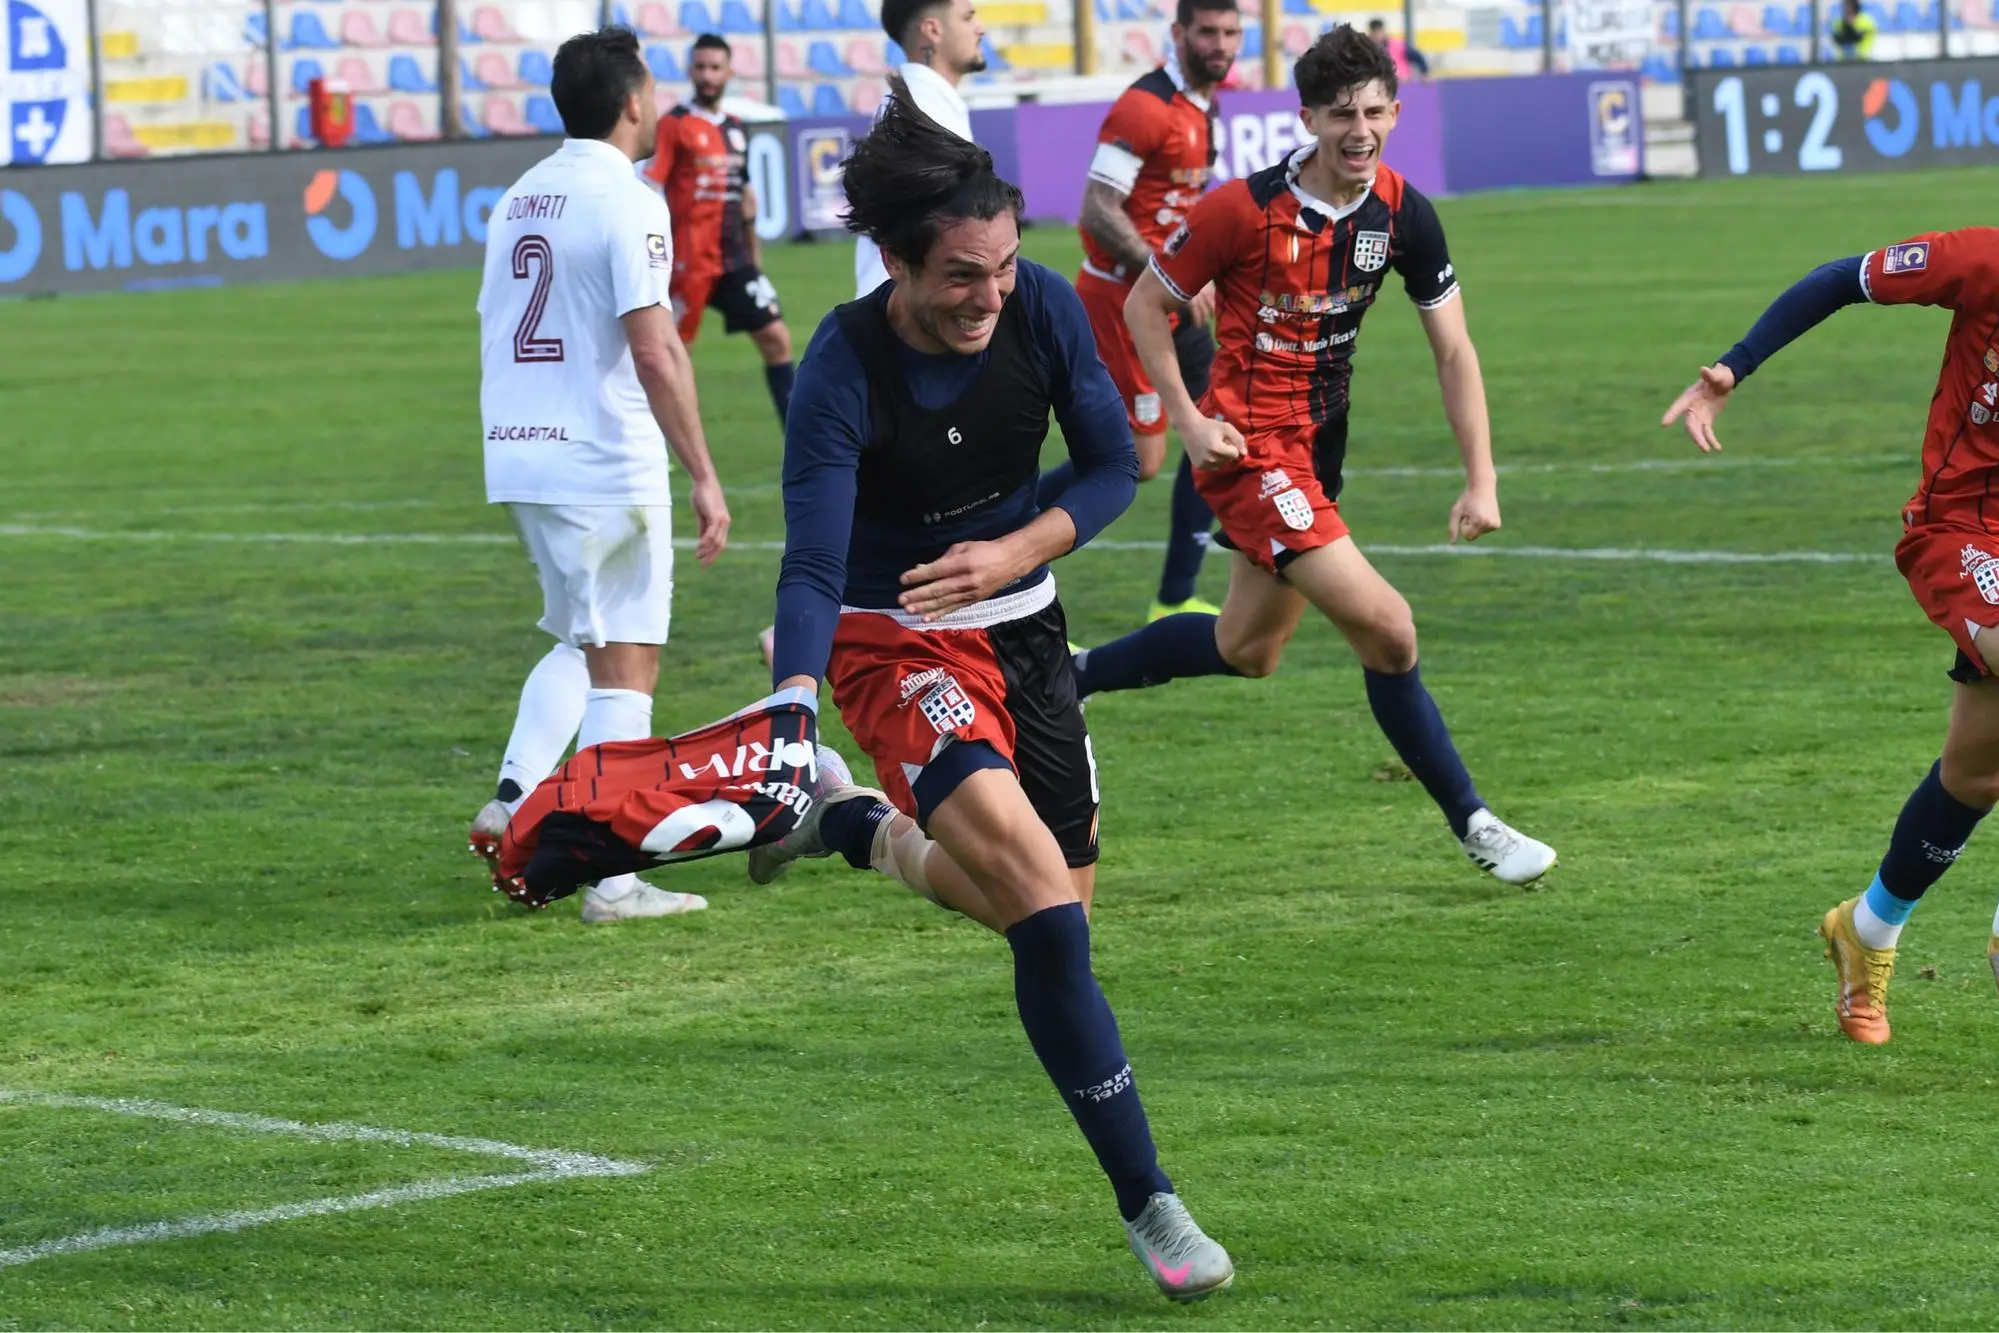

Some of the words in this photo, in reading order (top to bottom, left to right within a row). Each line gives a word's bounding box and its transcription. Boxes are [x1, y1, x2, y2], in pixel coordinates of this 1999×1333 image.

[1713, 71, 1843, 175] 1:2
[507, 194, 567, 221] DONATI
[59, 188, 269, 271] Mara
[512, 235, 564, 363] 2
[1303, 338, 1328, 352] Mario
[947, 426, 963, 445] 6
[920, 679, 954, 707] TORRES
